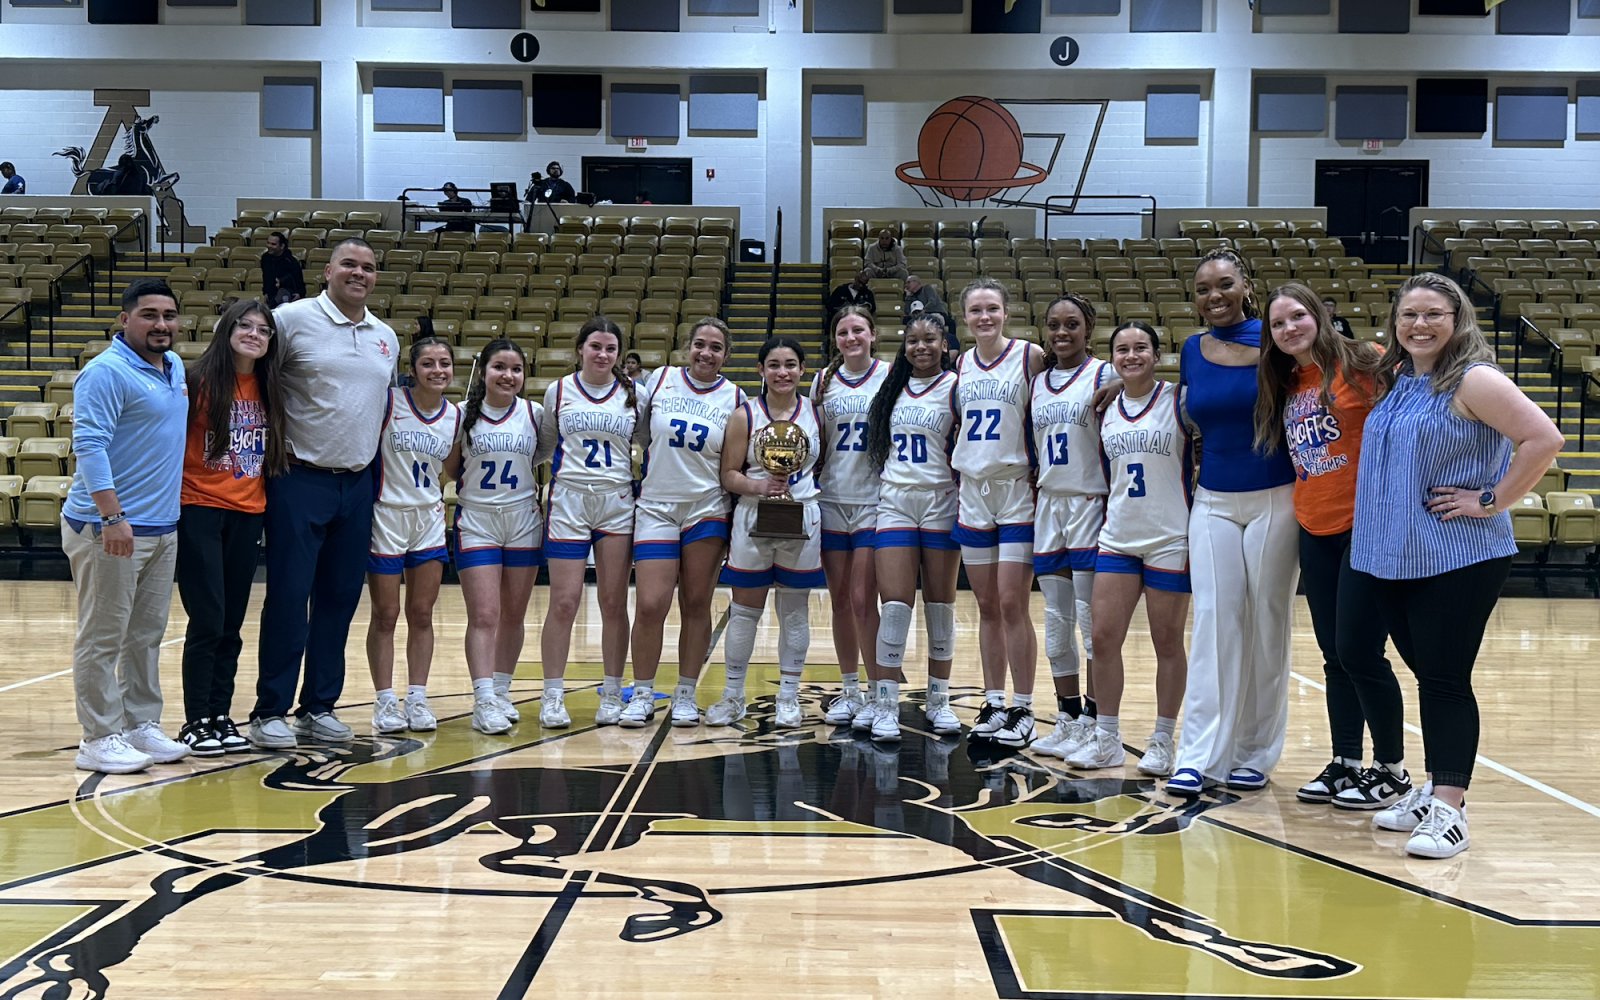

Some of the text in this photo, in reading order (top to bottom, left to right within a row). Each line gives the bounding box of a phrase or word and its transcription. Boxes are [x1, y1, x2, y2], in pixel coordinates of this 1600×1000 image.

[1058, 41, 1070, 61] J
[661, 397, 728, 430] CENTRAL
[823, 395, 873, 421] CENTR
[890, 405, 946, 434] ENTRAL
[562, 411, 632, 439] CENTRAL
[669, 418, 709, 452] 33
[836, 422, 869, 451] 23
[967, 409, 1001, 441] 22
[390, 431, 449, 461] CENTRA
[582, 439, 612, 468] 21
[893, 433, 928, 463] 20
[1047, 433, 1069, 466] 13
[1103, 430, 1172, 461] CENTRAL
[480, 460, 518, 490] 24
[1127, 463, 1146, 498] 3
